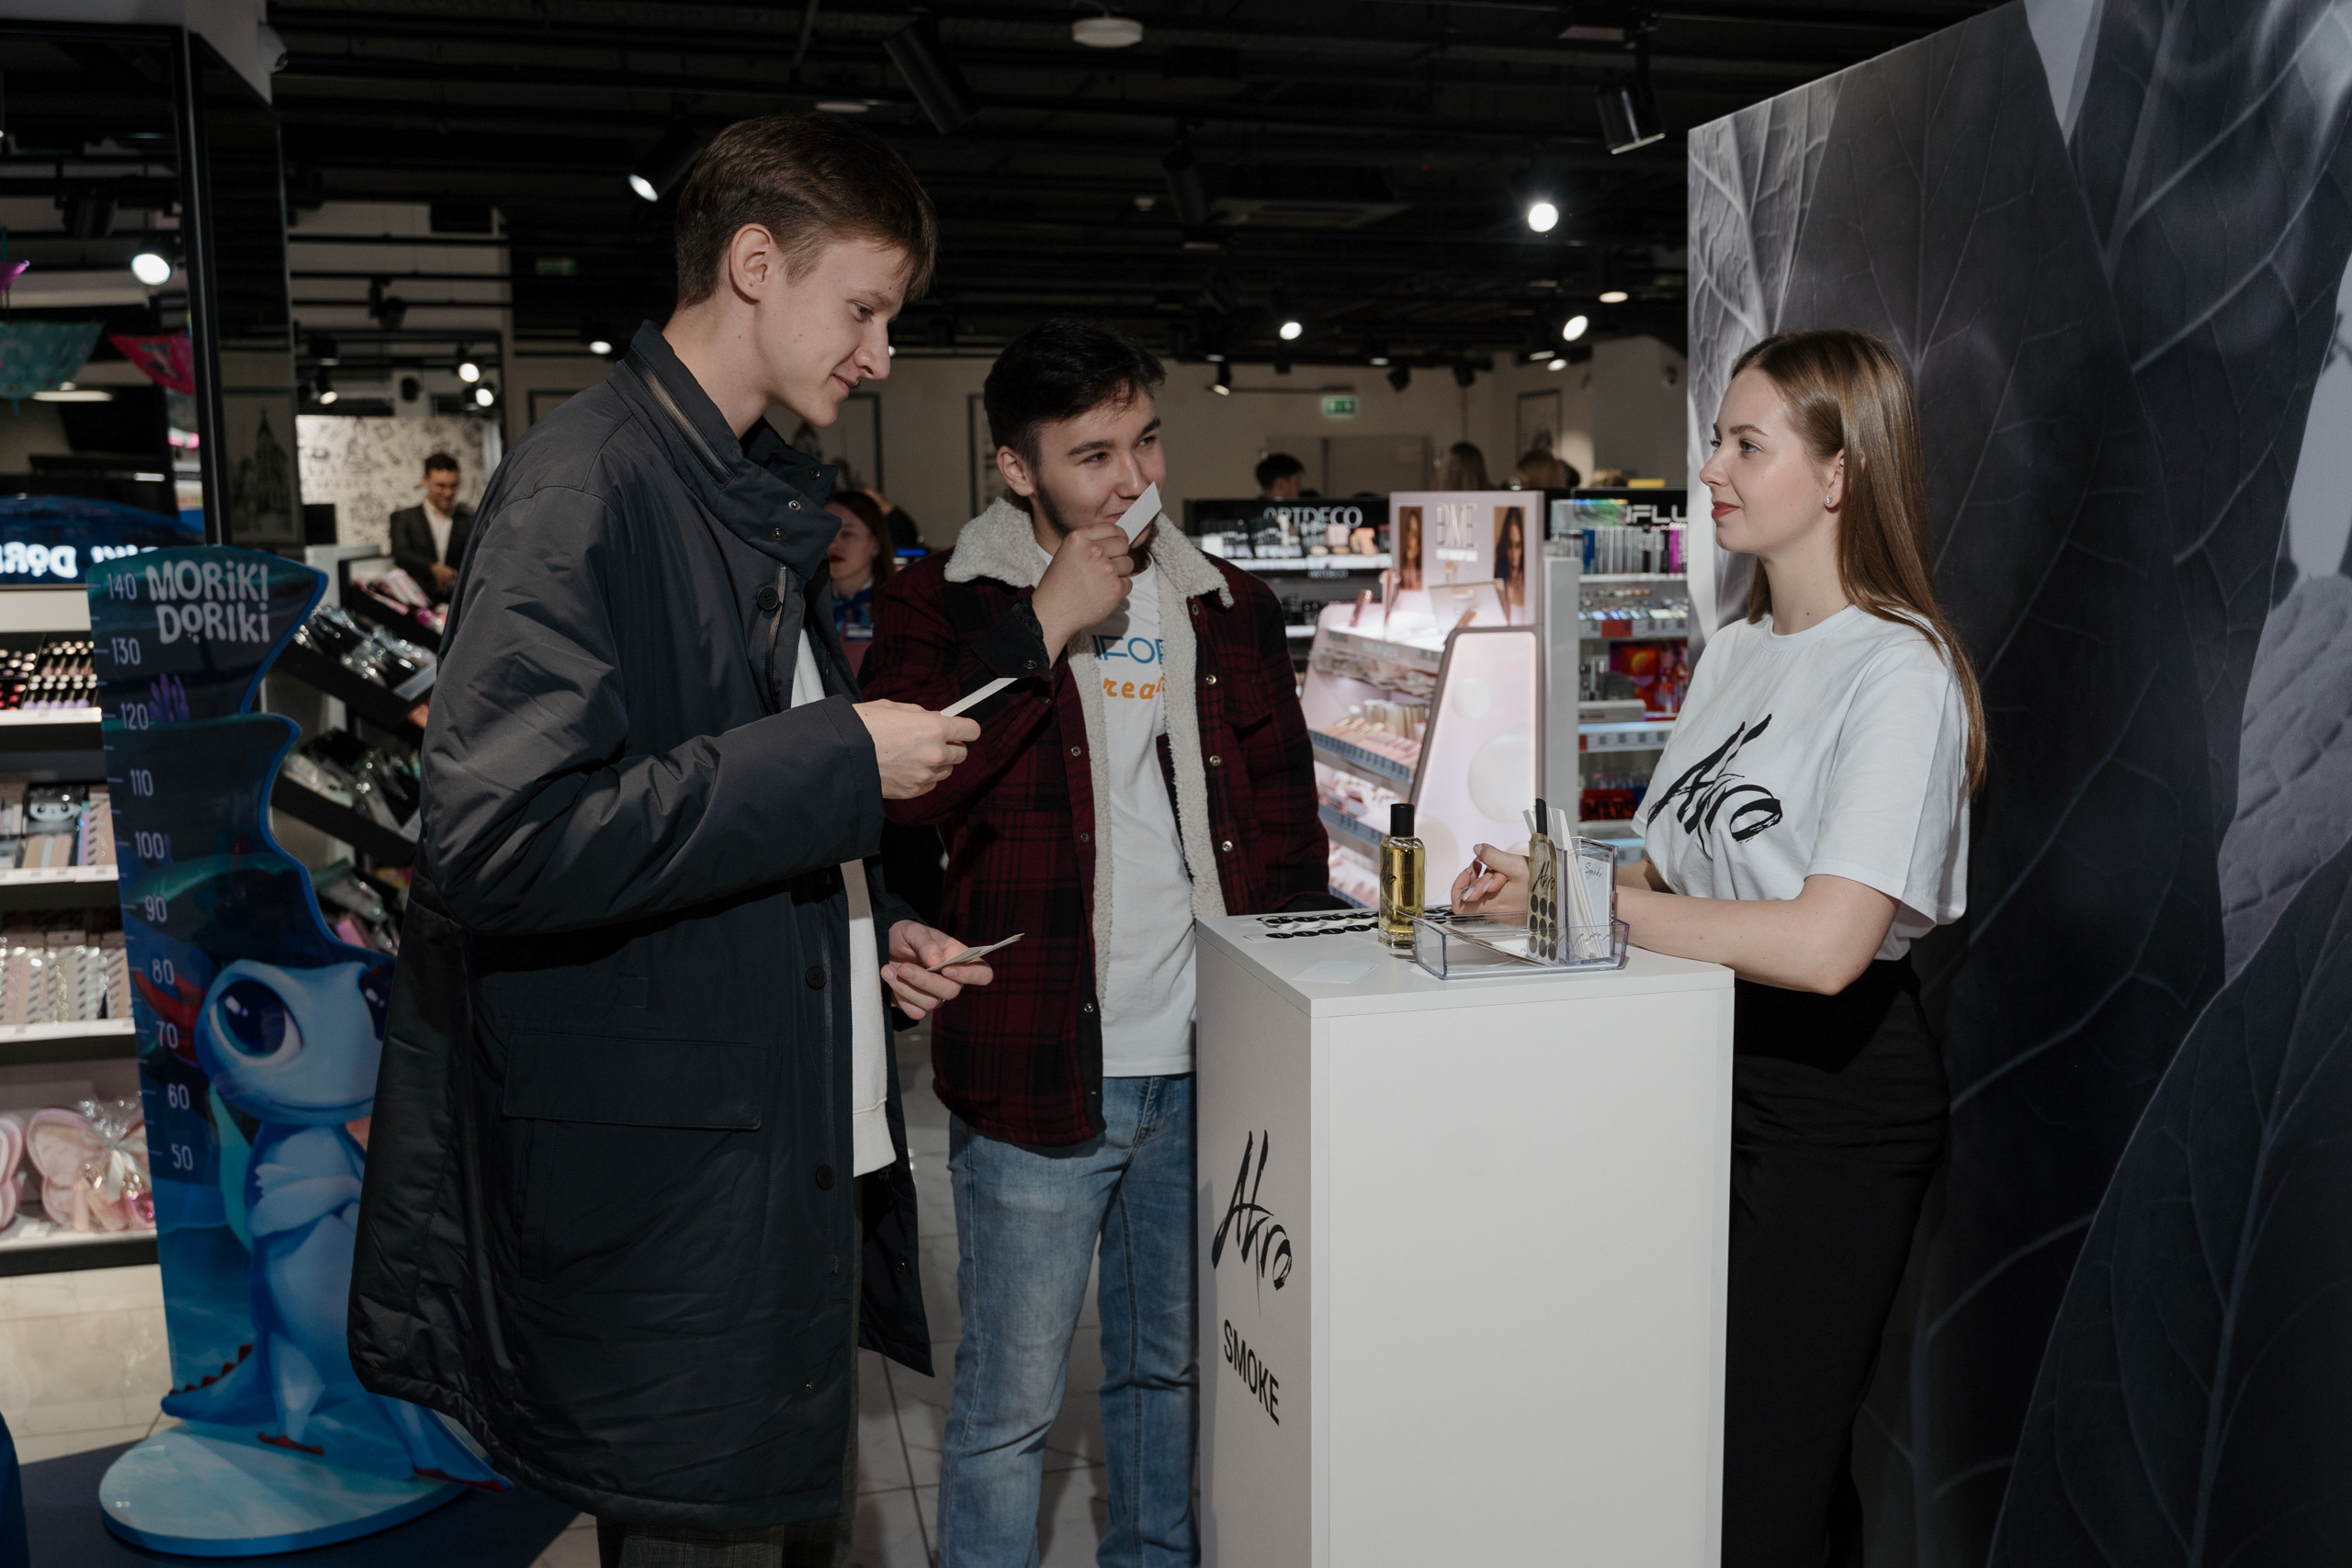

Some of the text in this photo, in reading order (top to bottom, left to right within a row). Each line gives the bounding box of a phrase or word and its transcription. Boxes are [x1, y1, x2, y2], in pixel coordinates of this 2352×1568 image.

[107, 572, 138, 601] 140
[112, 637, 141, 666] 130
[121, 702, 149, 730] 120
[130, 769, 154, 796] 110
[135, 831, 164, 860] 100
[144, 895, 168, 922] 90
[153, 958, 175, 986] 80
[156, 1021, 179, 1049] 70
[167, 1083, 190, 1110] 60
[171, 1144, 194, 1171] 50
[1224, 1319, 1280, 1427] SMOKE
